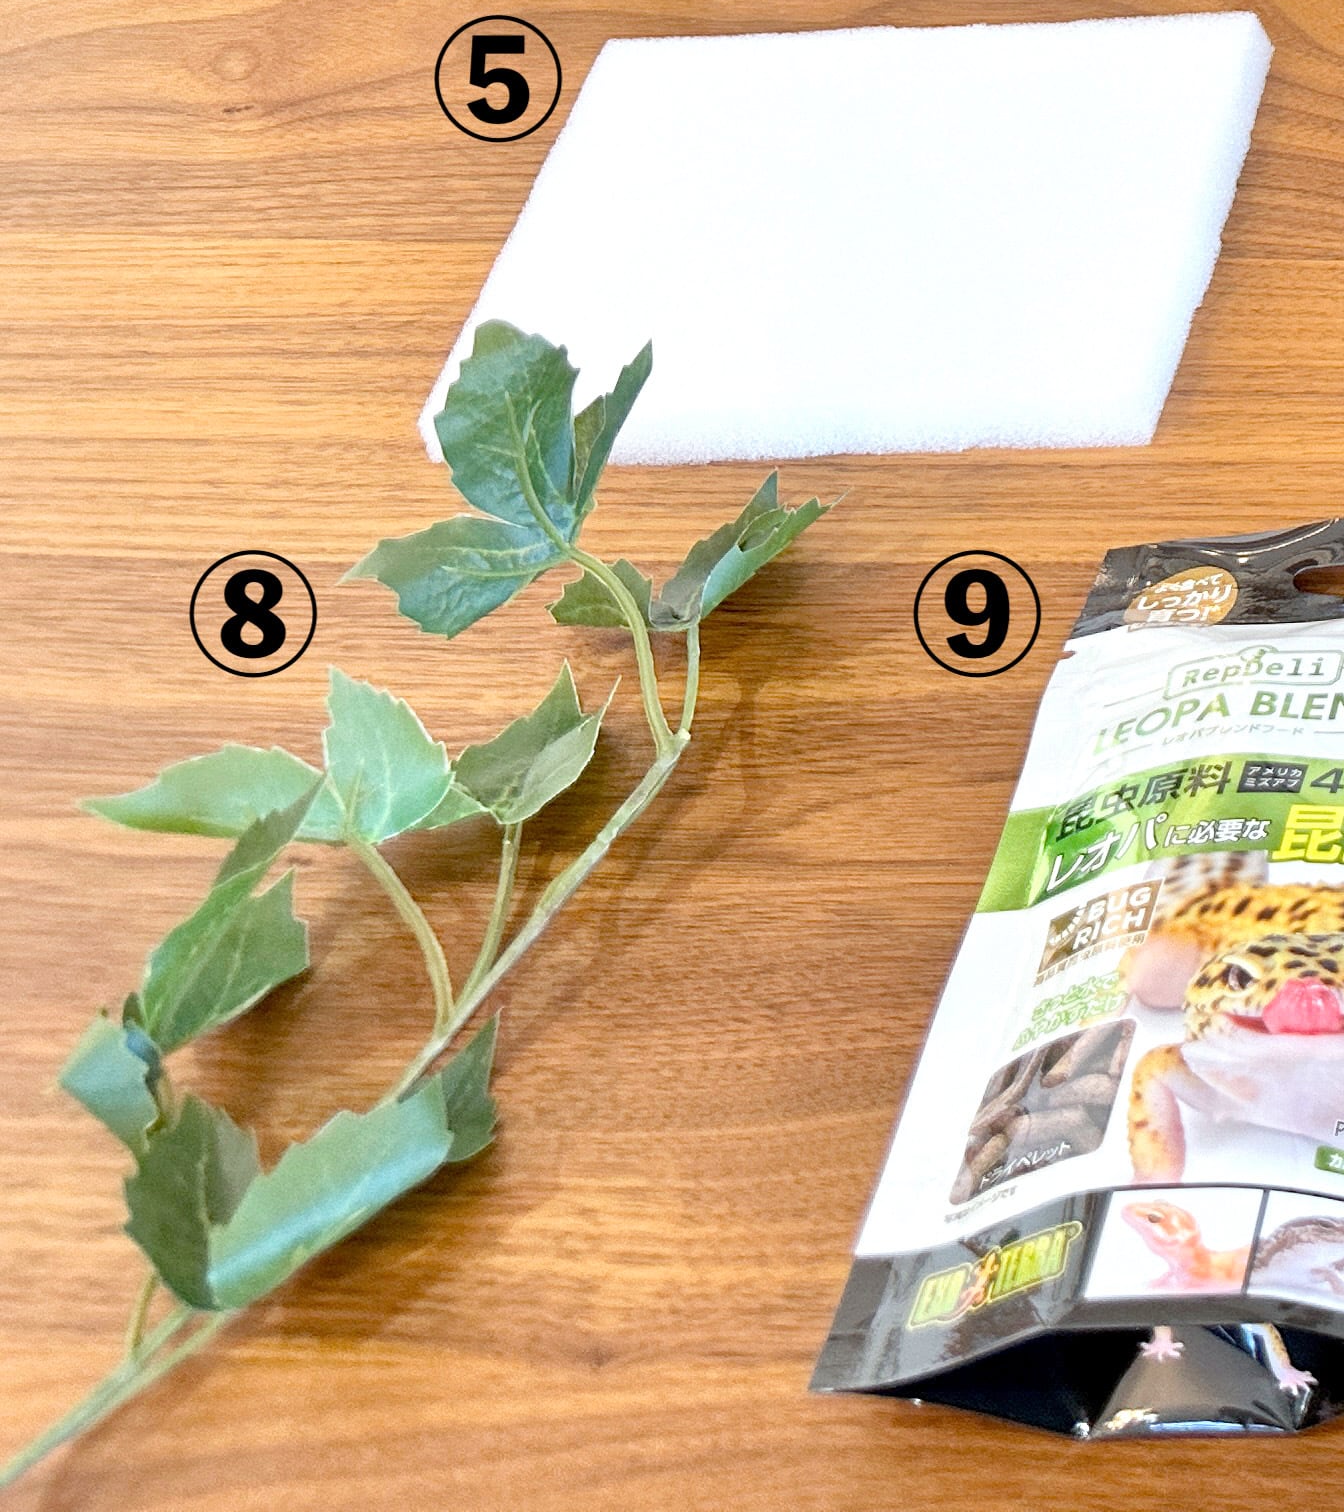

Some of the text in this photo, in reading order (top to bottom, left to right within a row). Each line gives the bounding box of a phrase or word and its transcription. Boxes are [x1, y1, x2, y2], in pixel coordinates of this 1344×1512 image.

[1136, 584, 1233, 611] しっかり
[1181, 656, 1326, 688] RepDeli
[1092, 691, 1232, 756] LEOPA
[1247, 766, 1303, 778] アメリカ
[1055, 759, 1233, 843] 昆虫原料
[1045, 812, 1273, 893] レオパに必要な
[1087, 886, 1153, 923] BUG
[1072, 907, 1147, 951] RICH
